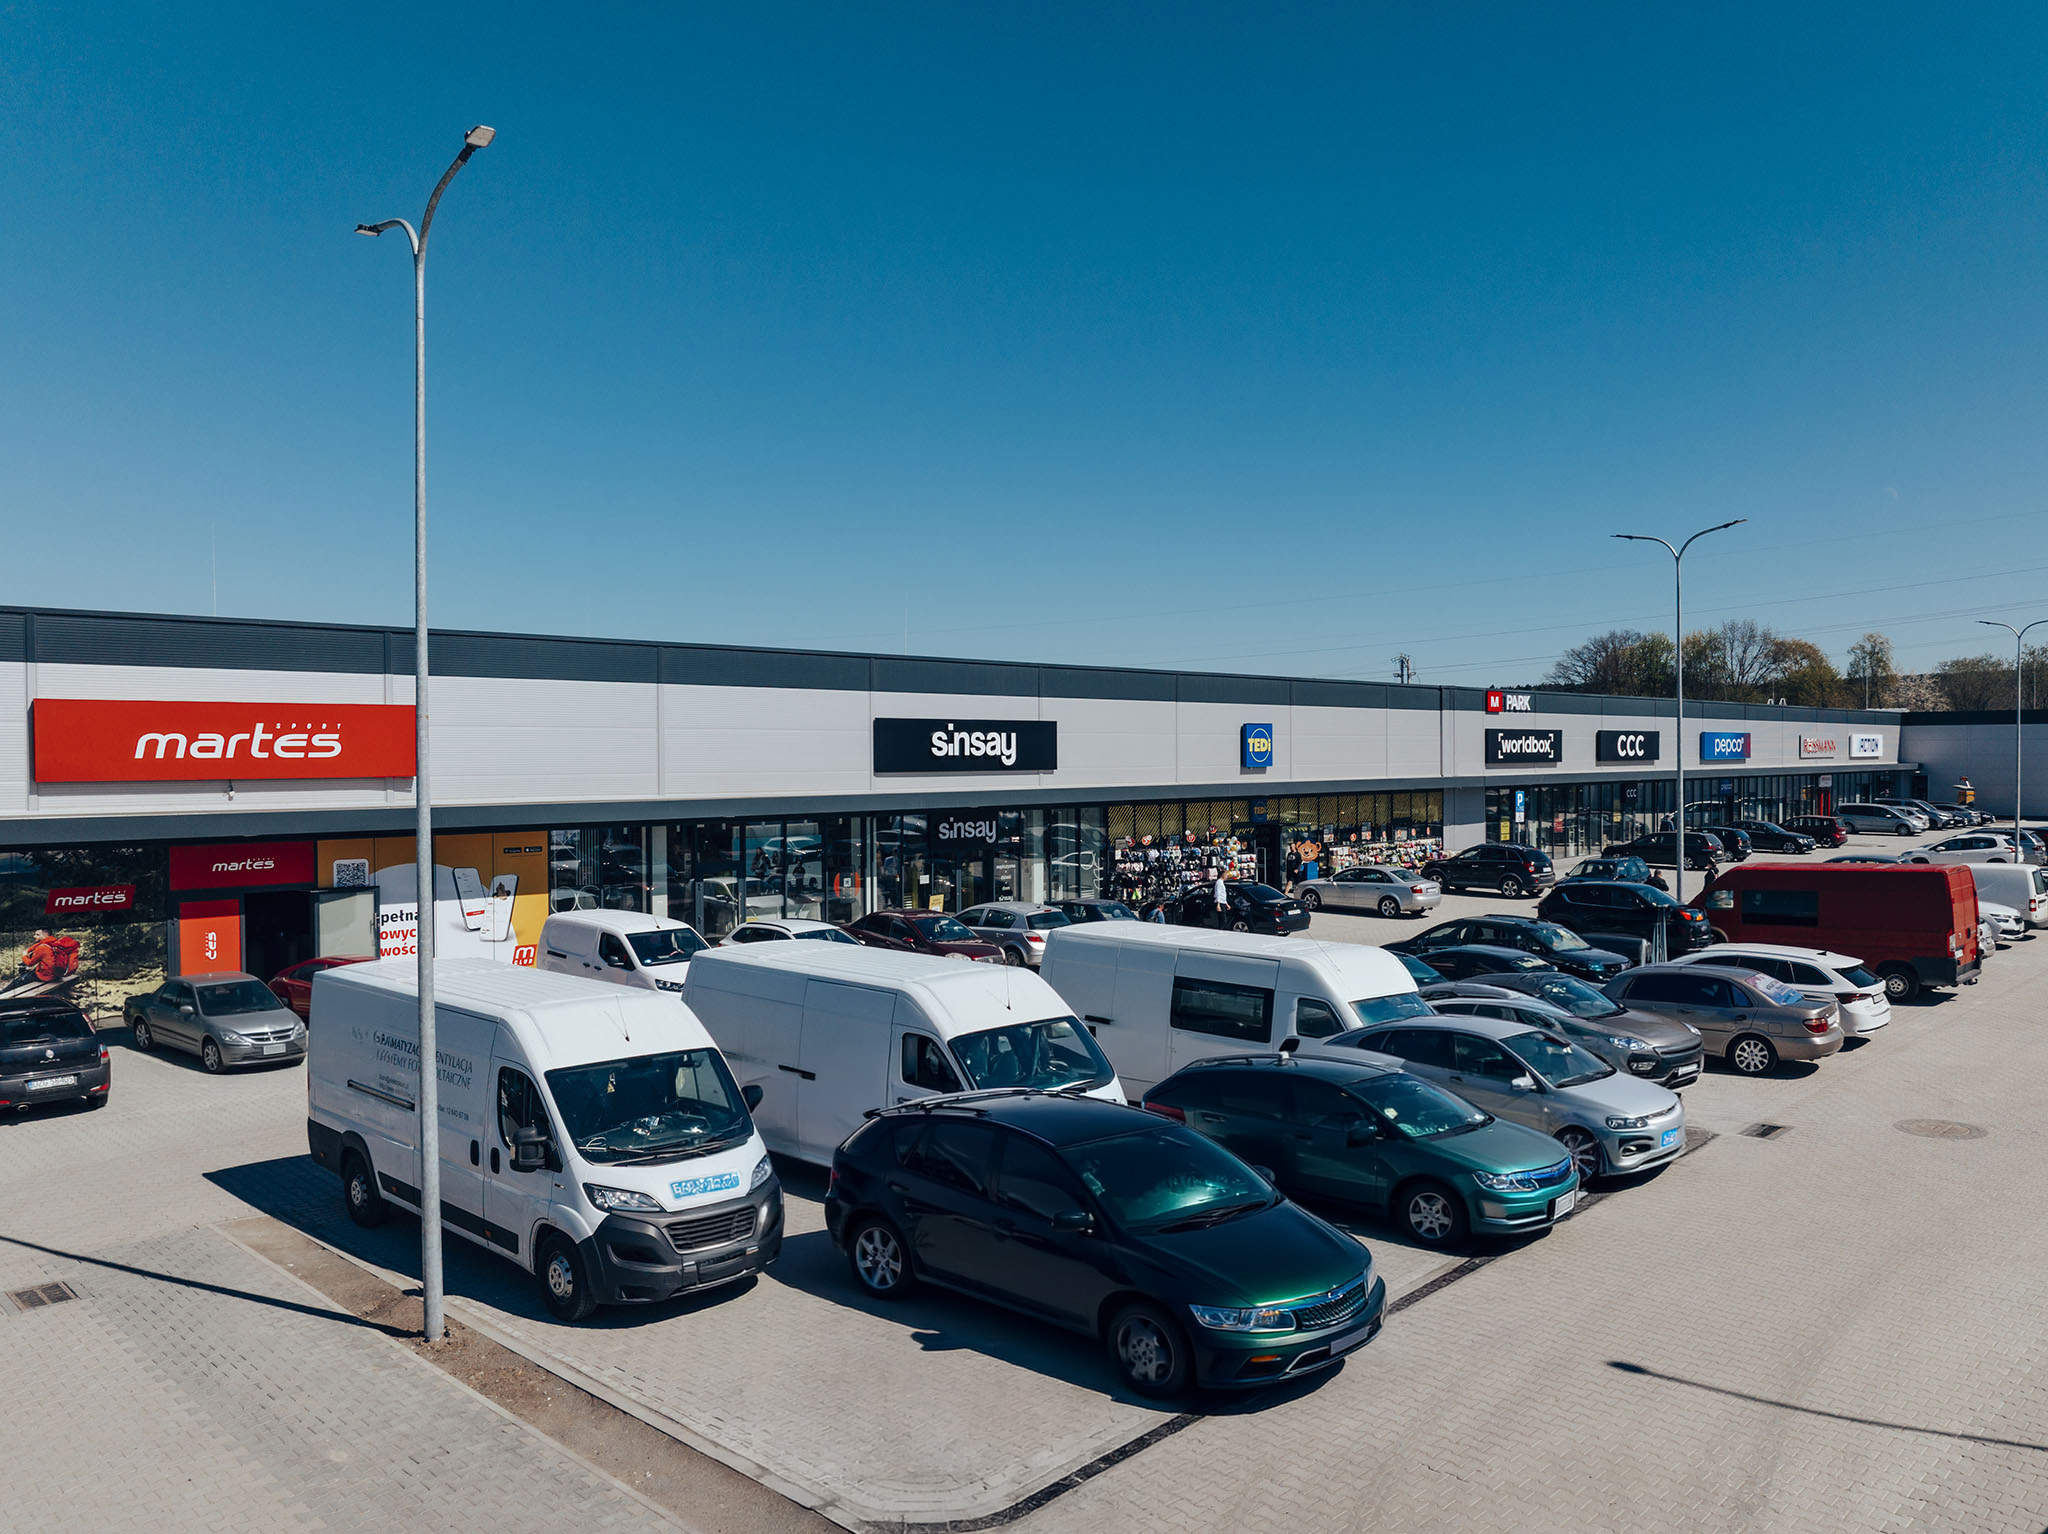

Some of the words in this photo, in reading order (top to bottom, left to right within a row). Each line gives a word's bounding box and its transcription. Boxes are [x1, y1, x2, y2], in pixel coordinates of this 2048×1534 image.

[1490, 696, 1499, 707] M
[1506, 694, 1531, 711] PARK
[134, 723, 342, 759] martes
[931, 723, 1016, 766] sinsay
[1247, 738, 1271, 752] TEDi
[1617, 734, 1644, 757] CCC
[1714, 738, 1743, 756] pepco
[1517, 793, 1523, 807] P
[1626, 789, 1637, 798] CCC
[938, 817, 996, 844] sinsay
[212, 858, 275, 872] martes
[54, 891, 126, 907] martes
[380, 928, 417, 942] owyc
[380, 942, 417, 957] wośc
[436, 1049, 473, 1073] ENTYLACJA
